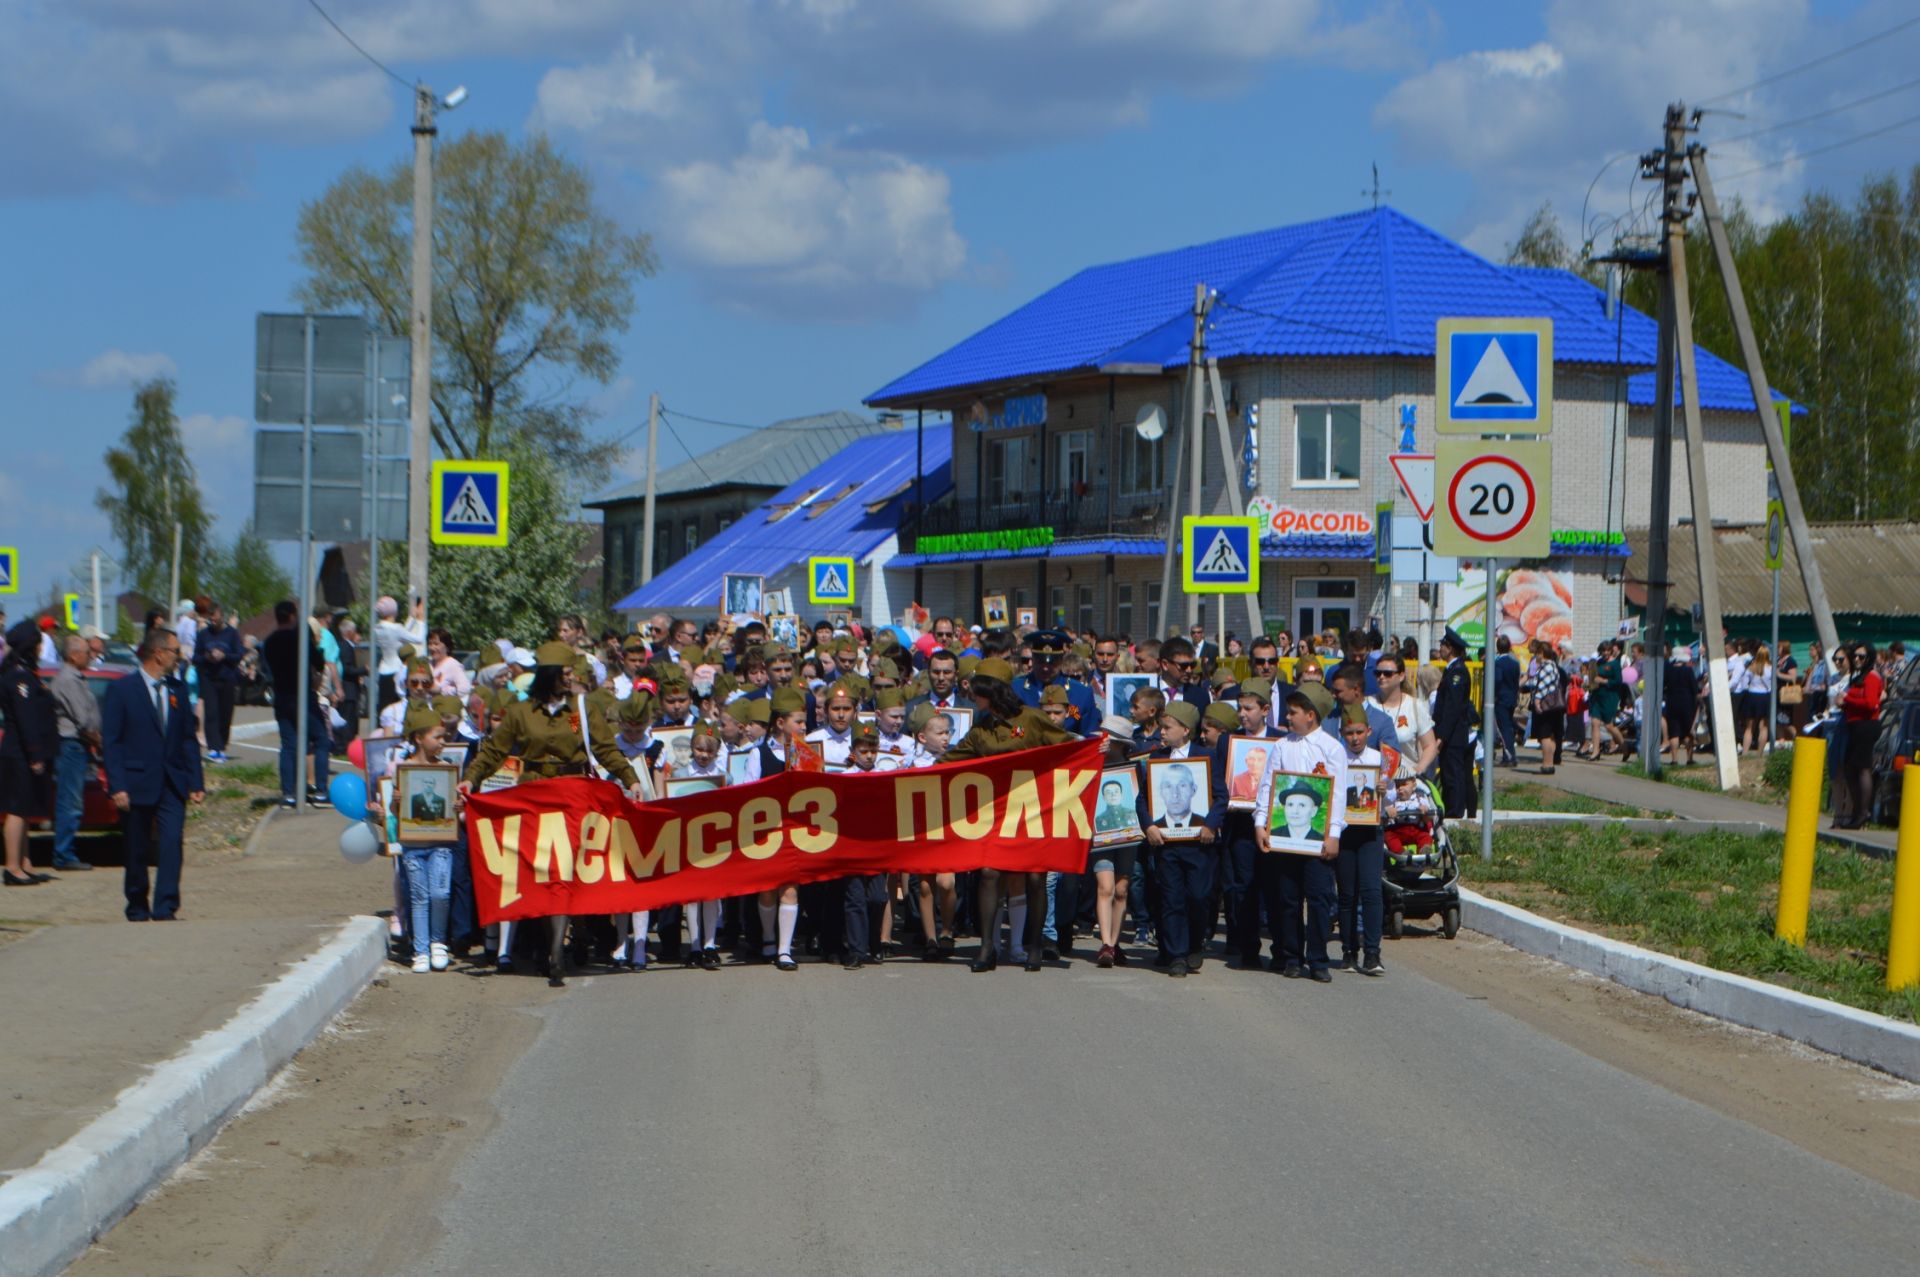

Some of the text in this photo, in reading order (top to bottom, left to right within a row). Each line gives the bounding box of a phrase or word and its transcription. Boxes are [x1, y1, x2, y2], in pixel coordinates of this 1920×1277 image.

[1469, 483, 1514, 515] 20
[1272, 510, 1370, 534] ФАСОЛЬ
[896, 768, 1098, 842] ПОЛК
